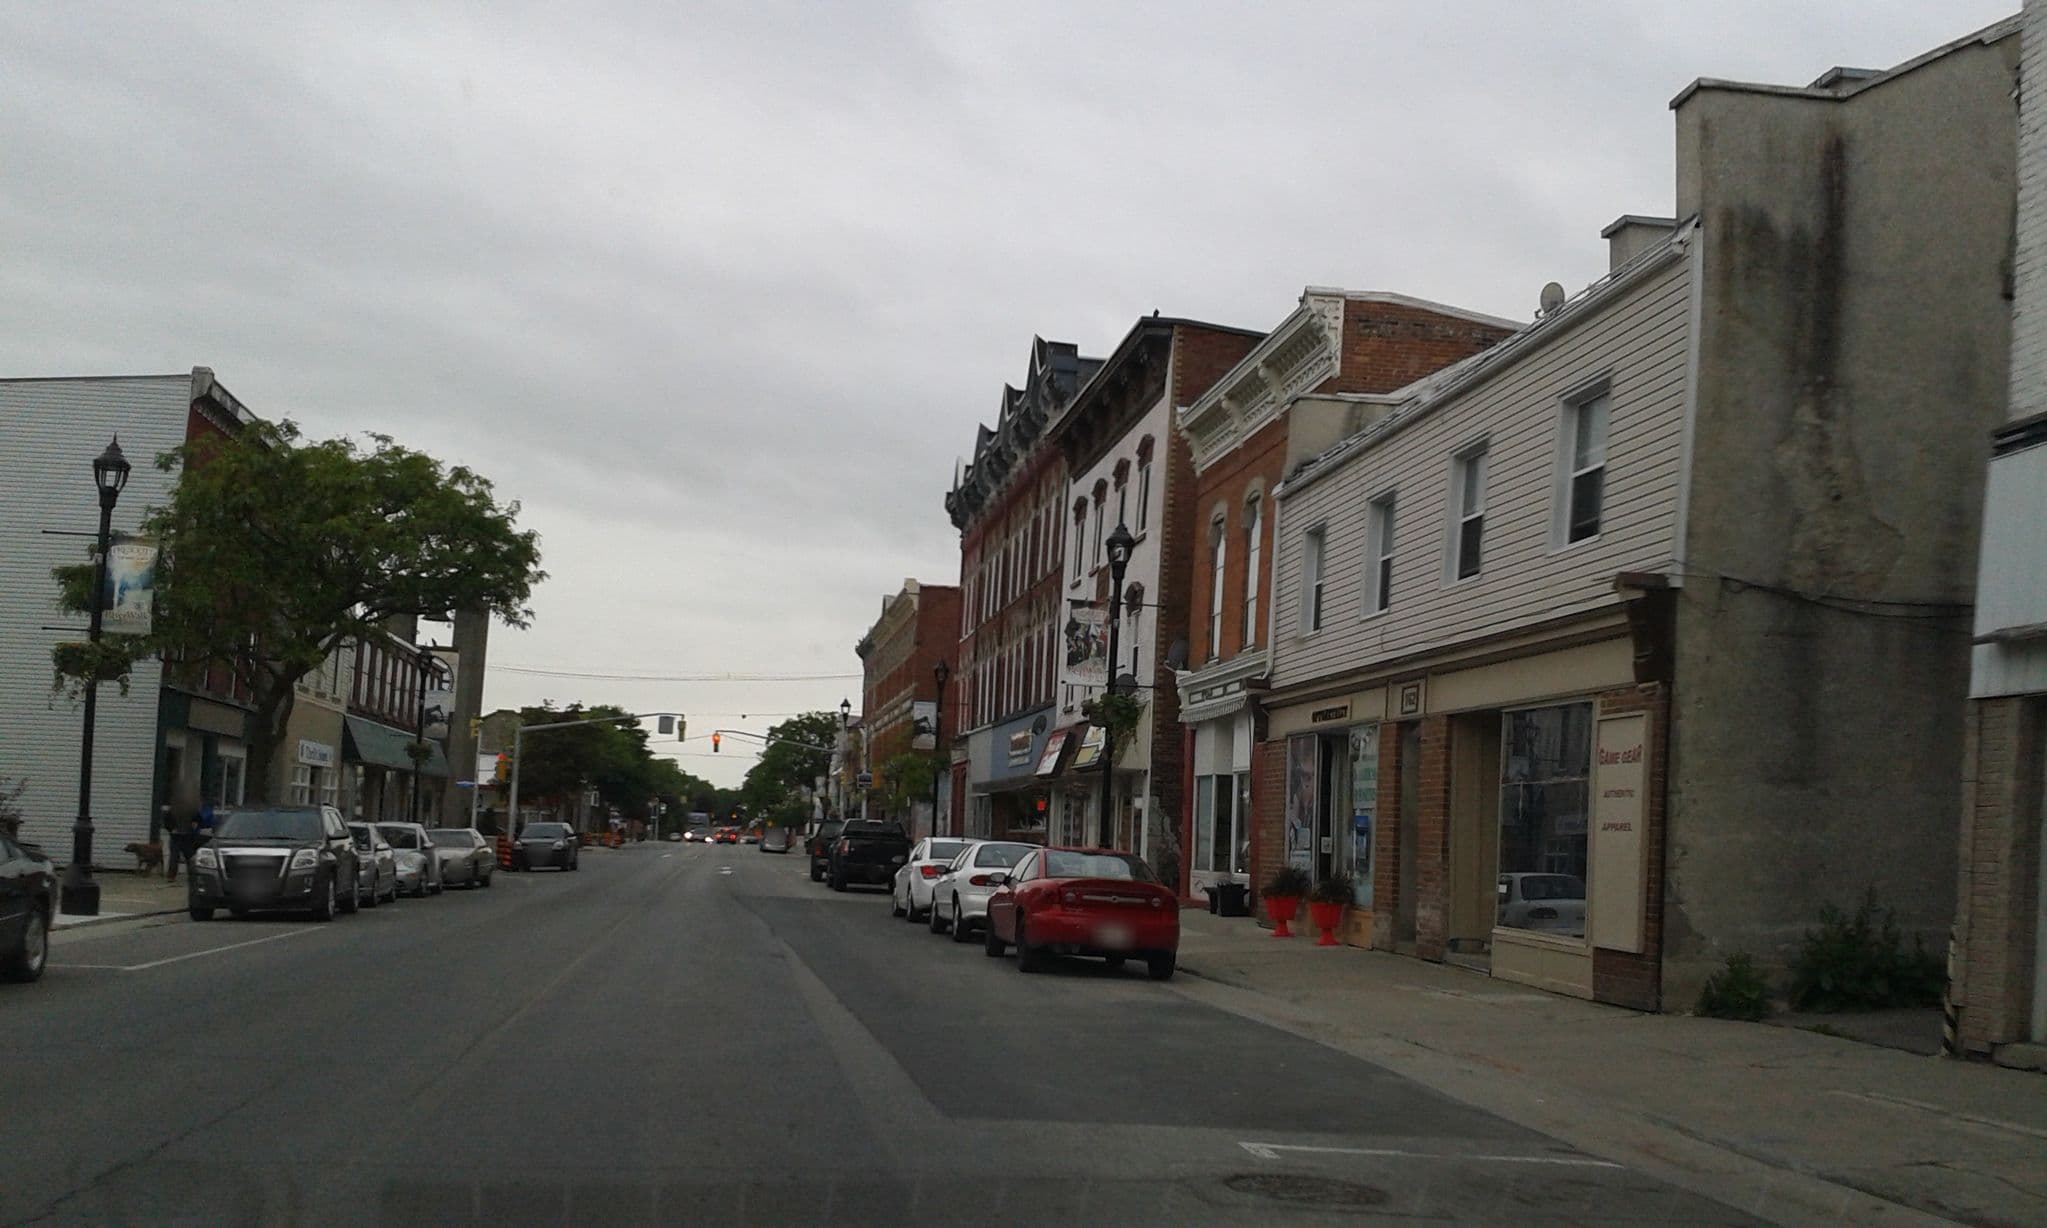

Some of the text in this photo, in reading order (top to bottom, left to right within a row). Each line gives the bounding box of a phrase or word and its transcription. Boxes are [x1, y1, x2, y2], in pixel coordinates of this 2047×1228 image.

[1599, 744, 1642, 765] GAME GEAR
[1603, 789, 1635, 798] AUTHENTIC
[1601, 822, 1633, 832] APPAREL
